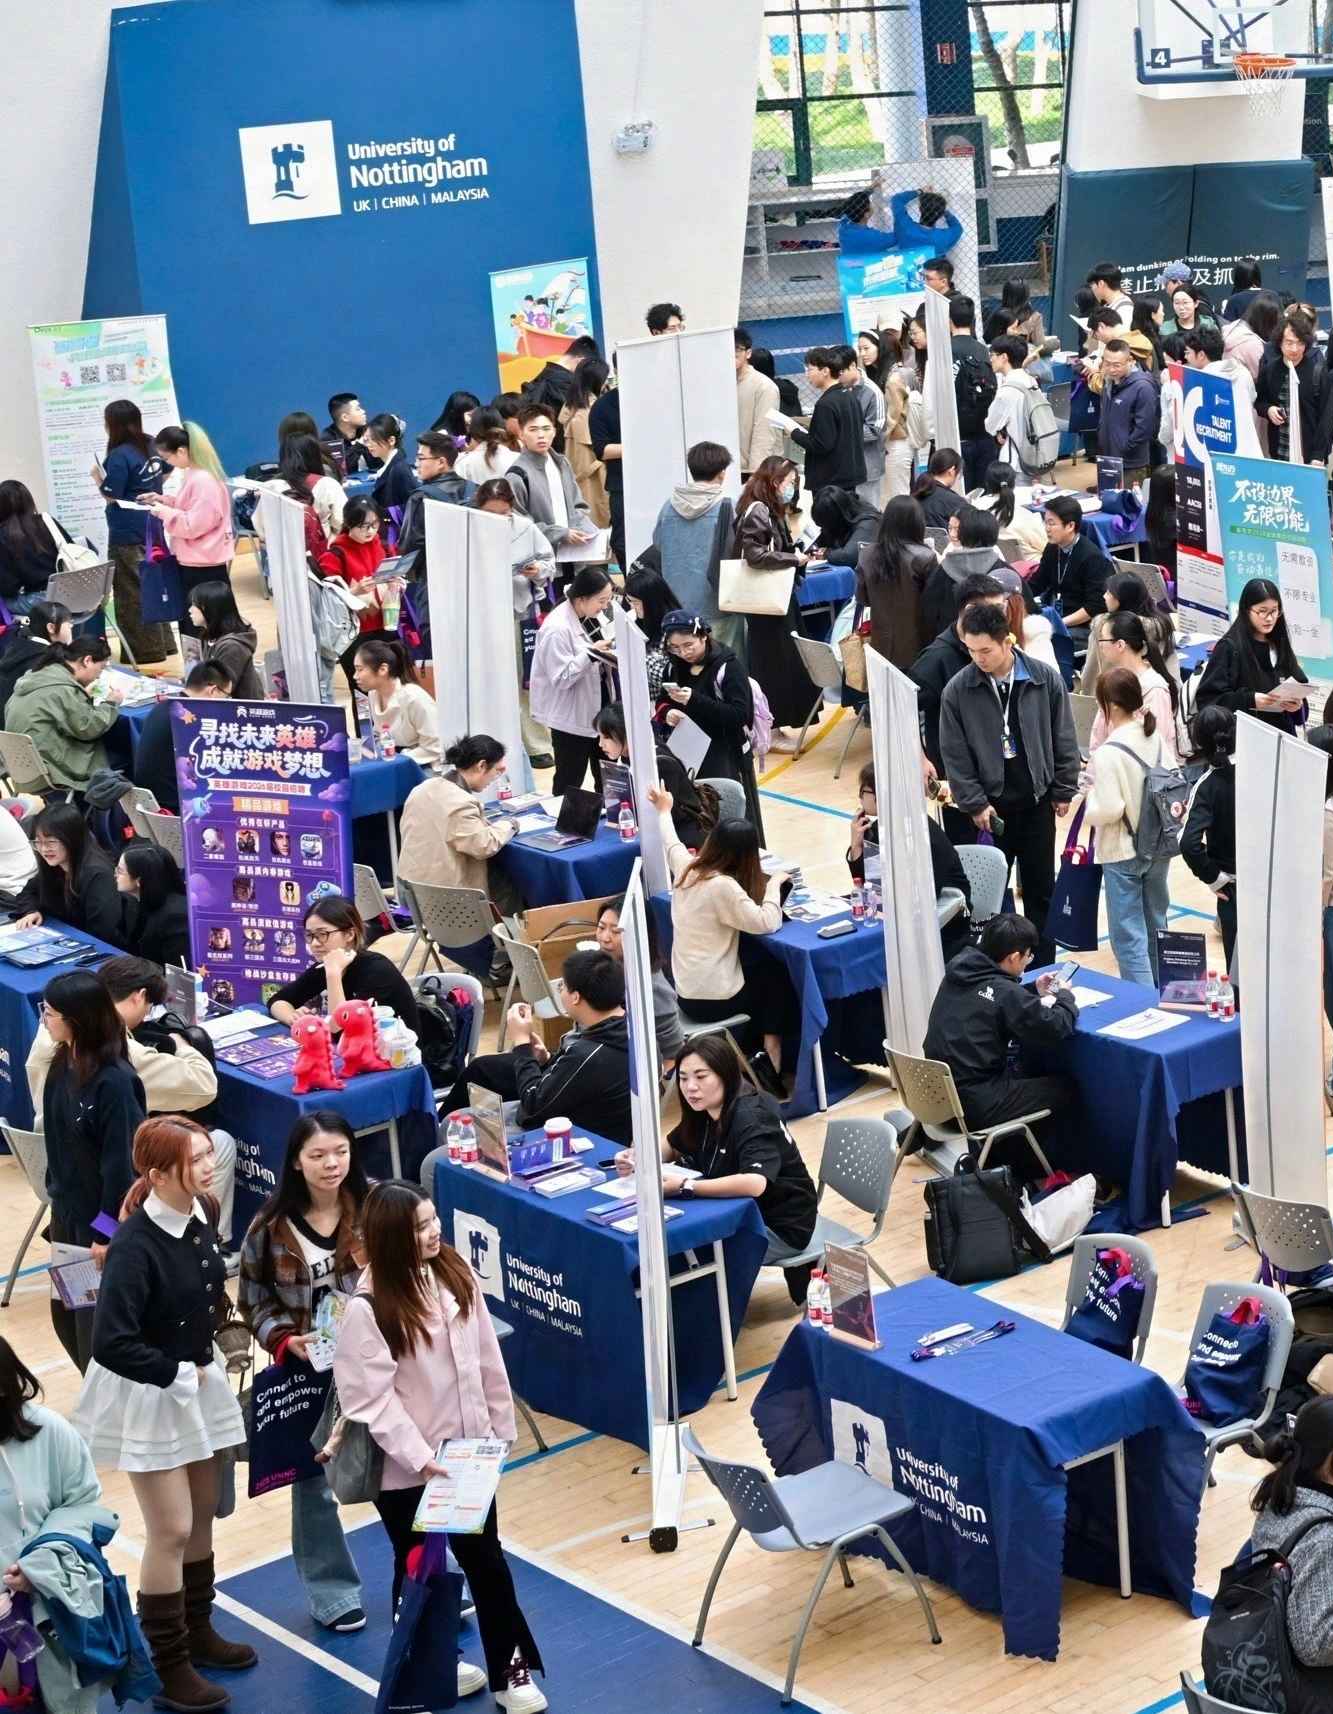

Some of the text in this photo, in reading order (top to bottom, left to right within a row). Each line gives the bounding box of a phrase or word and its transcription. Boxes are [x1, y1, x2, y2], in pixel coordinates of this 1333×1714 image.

[1154, 52, 1167, 66] 4
[347, 133, 456, 160] University of
[351, 156, 488, 188] Nottingham
[353, 187, 490, 212] UK CHINA MALAYSIA
[1262, 252, 1280, 261] rim.
[1211, 415, 1232, 431] TALENT
[1229, 478, 1301, 506] 不设边界
[200, 718, 318, 750] 寻找未来英雄
[200, 747, 332, 779] 成就游戏梦想
[506, 1252, 563, 1287] University of
[507, 1270, 582, 1318] Nottingham
[525, 1304, 546, 1322] CHINA
[551, 1316, 583, 1338] MALAYSIA
[294, 1371, 306, 1382] to
[272, 1384, 323, 1409] empower
[279, 1399, 310, 1420] future
[271, 1467, 297, 1485] UNNC
[895, 1447, 959, 1491] University of
[899, 1465, 987, 1524] Nottingham
[919, 1502, 989, 1546] CHINA MALAYSIA
